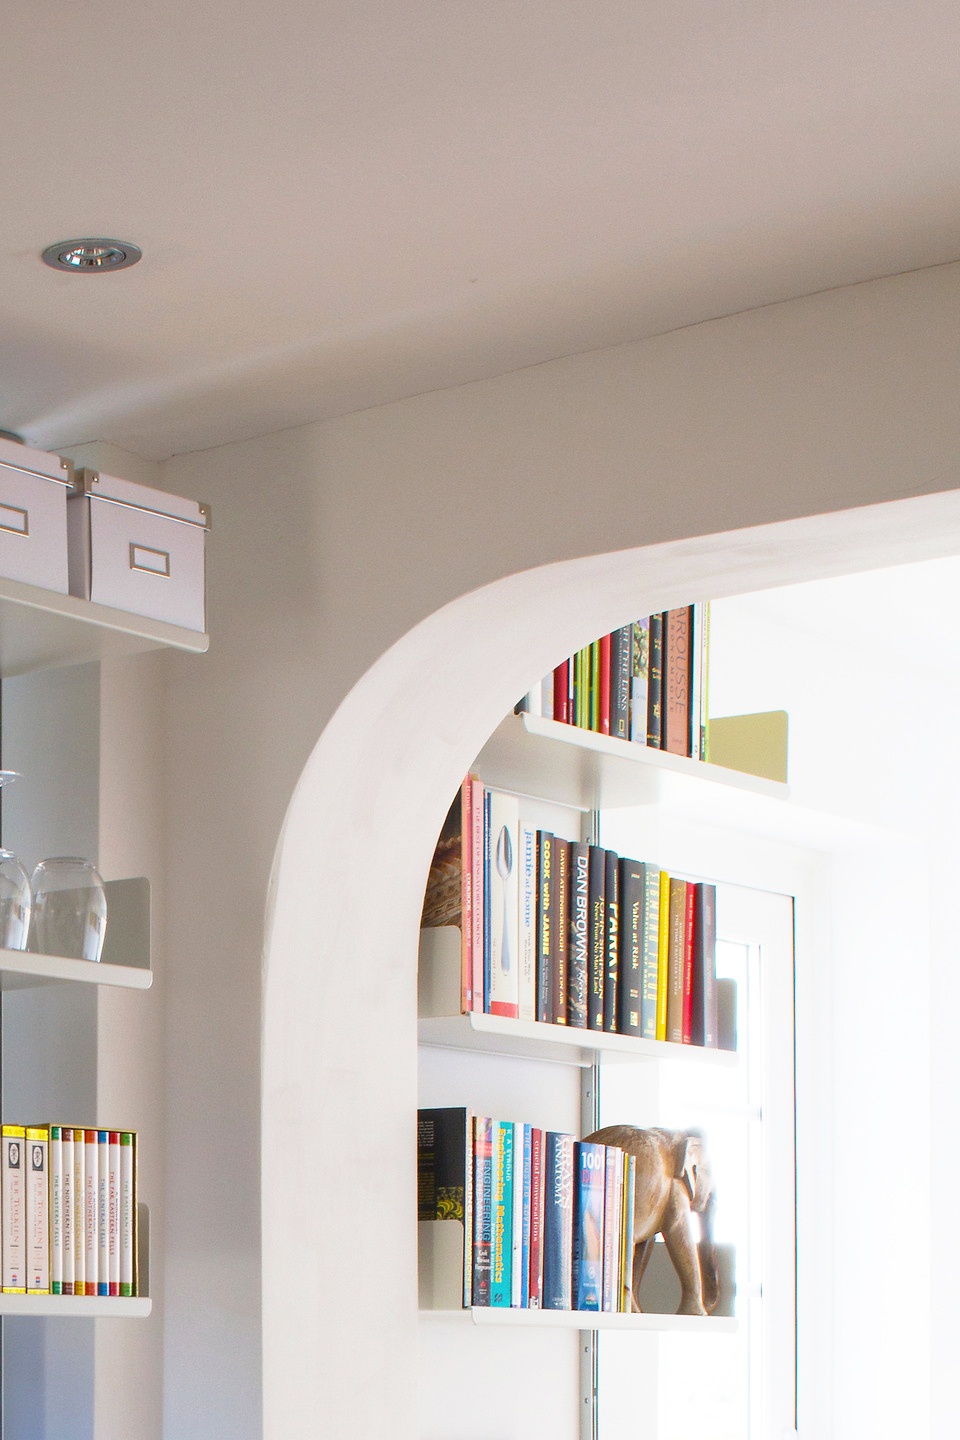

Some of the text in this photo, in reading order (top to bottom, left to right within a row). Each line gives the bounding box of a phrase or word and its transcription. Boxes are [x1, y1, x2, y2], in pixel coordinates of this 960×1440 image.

[675, 607, 687, 714] AROUSSE
[620, 679, 628, 711] LENS
[524, 829, 534, 877] jamie
[543, 840, 551, 879] COOK
[575, 855, 588, 962] DAN BROWN
[632, 901, 640, 931] Value
[594, 942, 599, 953] No
[632, 932, 638, 944] at
[647, 871, 659, 1001] SIGMUND FREUD
[554, 1137, 562, 1206] ANATOMY
[36, 1201, 44, 1244] TOLKIEN
[483, 1159, 491, 1241] ENGINEERING
[494, 1127, 506, 1283] Engineering Mathematics
